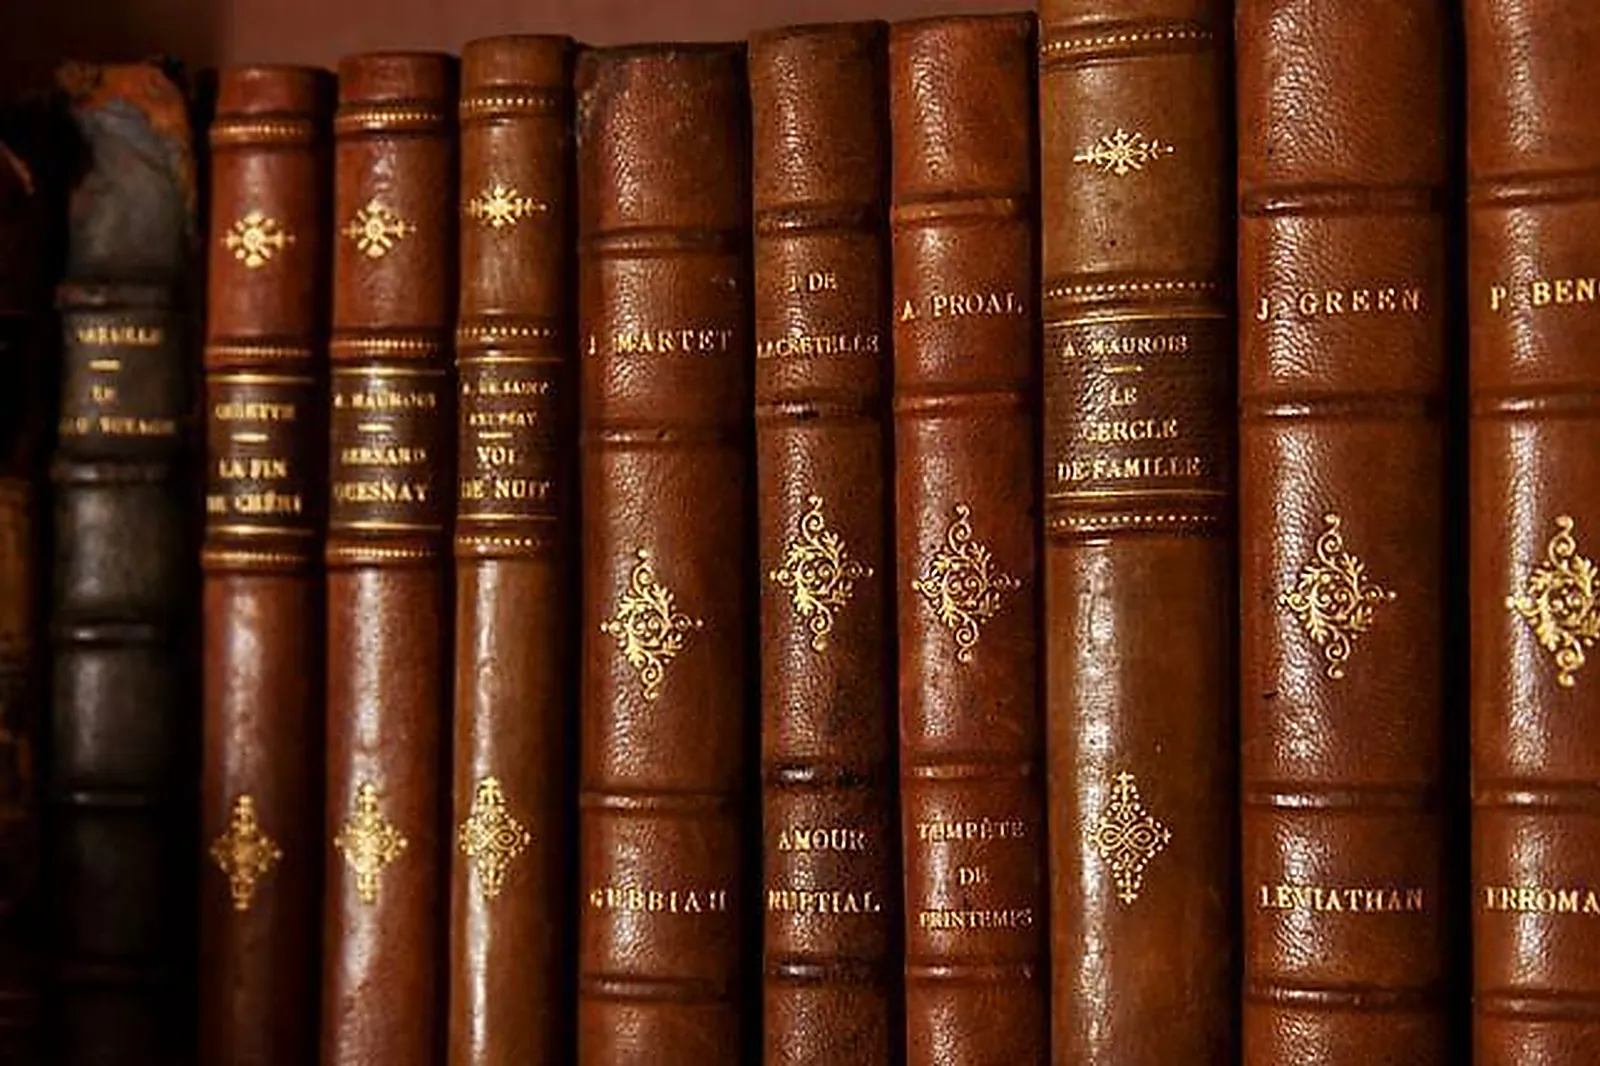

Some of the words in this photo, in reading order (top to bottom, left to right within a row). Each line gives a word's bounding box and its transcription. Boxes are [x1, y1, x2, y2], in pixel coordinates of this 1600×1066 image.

[808, 272, 837, 292] DE
[1533, 278, 1600, 306] BEN
[933, 291, 1023, 318] PROAL
[1300, 287, 1419, 315] GREEN
[613, 328, 733, 353] MARTET
[1087, 334, 1188, 355] MAUROIS
[1110, 387, 1137, 406] LE
[1083, 419, 1178, 443] CERCLE
[778, 828, 868, 852] AMOUR
[1260, 884, 1424, 913] LEVIATHAN
